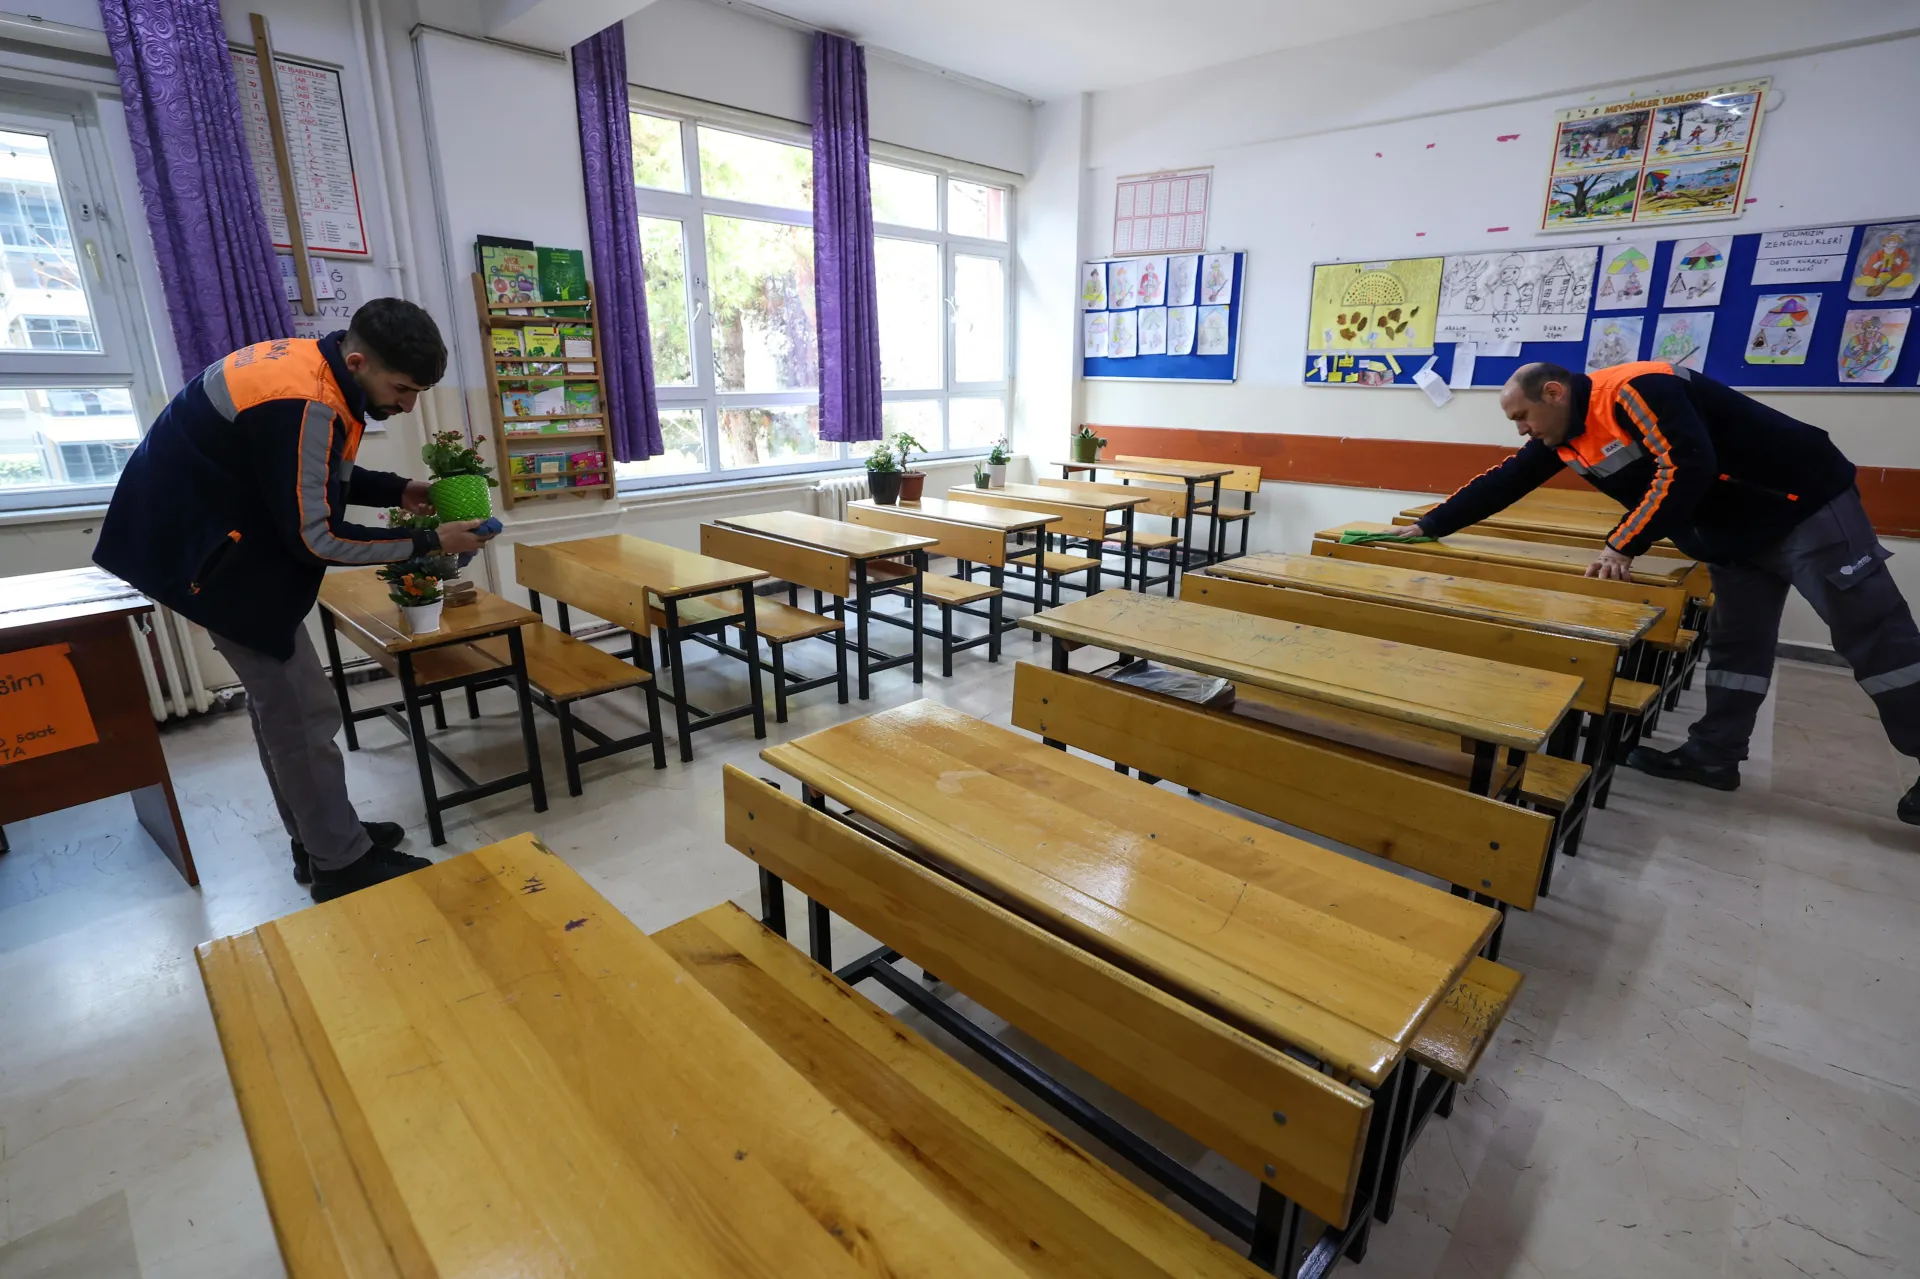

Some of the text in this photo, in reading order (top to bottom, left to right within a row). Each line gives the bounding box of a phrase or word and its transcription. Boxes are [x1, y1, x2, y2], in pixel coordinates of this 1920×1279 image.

[1604, 90, 1709, 114] MEVSİMLER TABLOSU
[1605, 443, 1620, 453] BAK
[16, 724, 57, 744] saat
